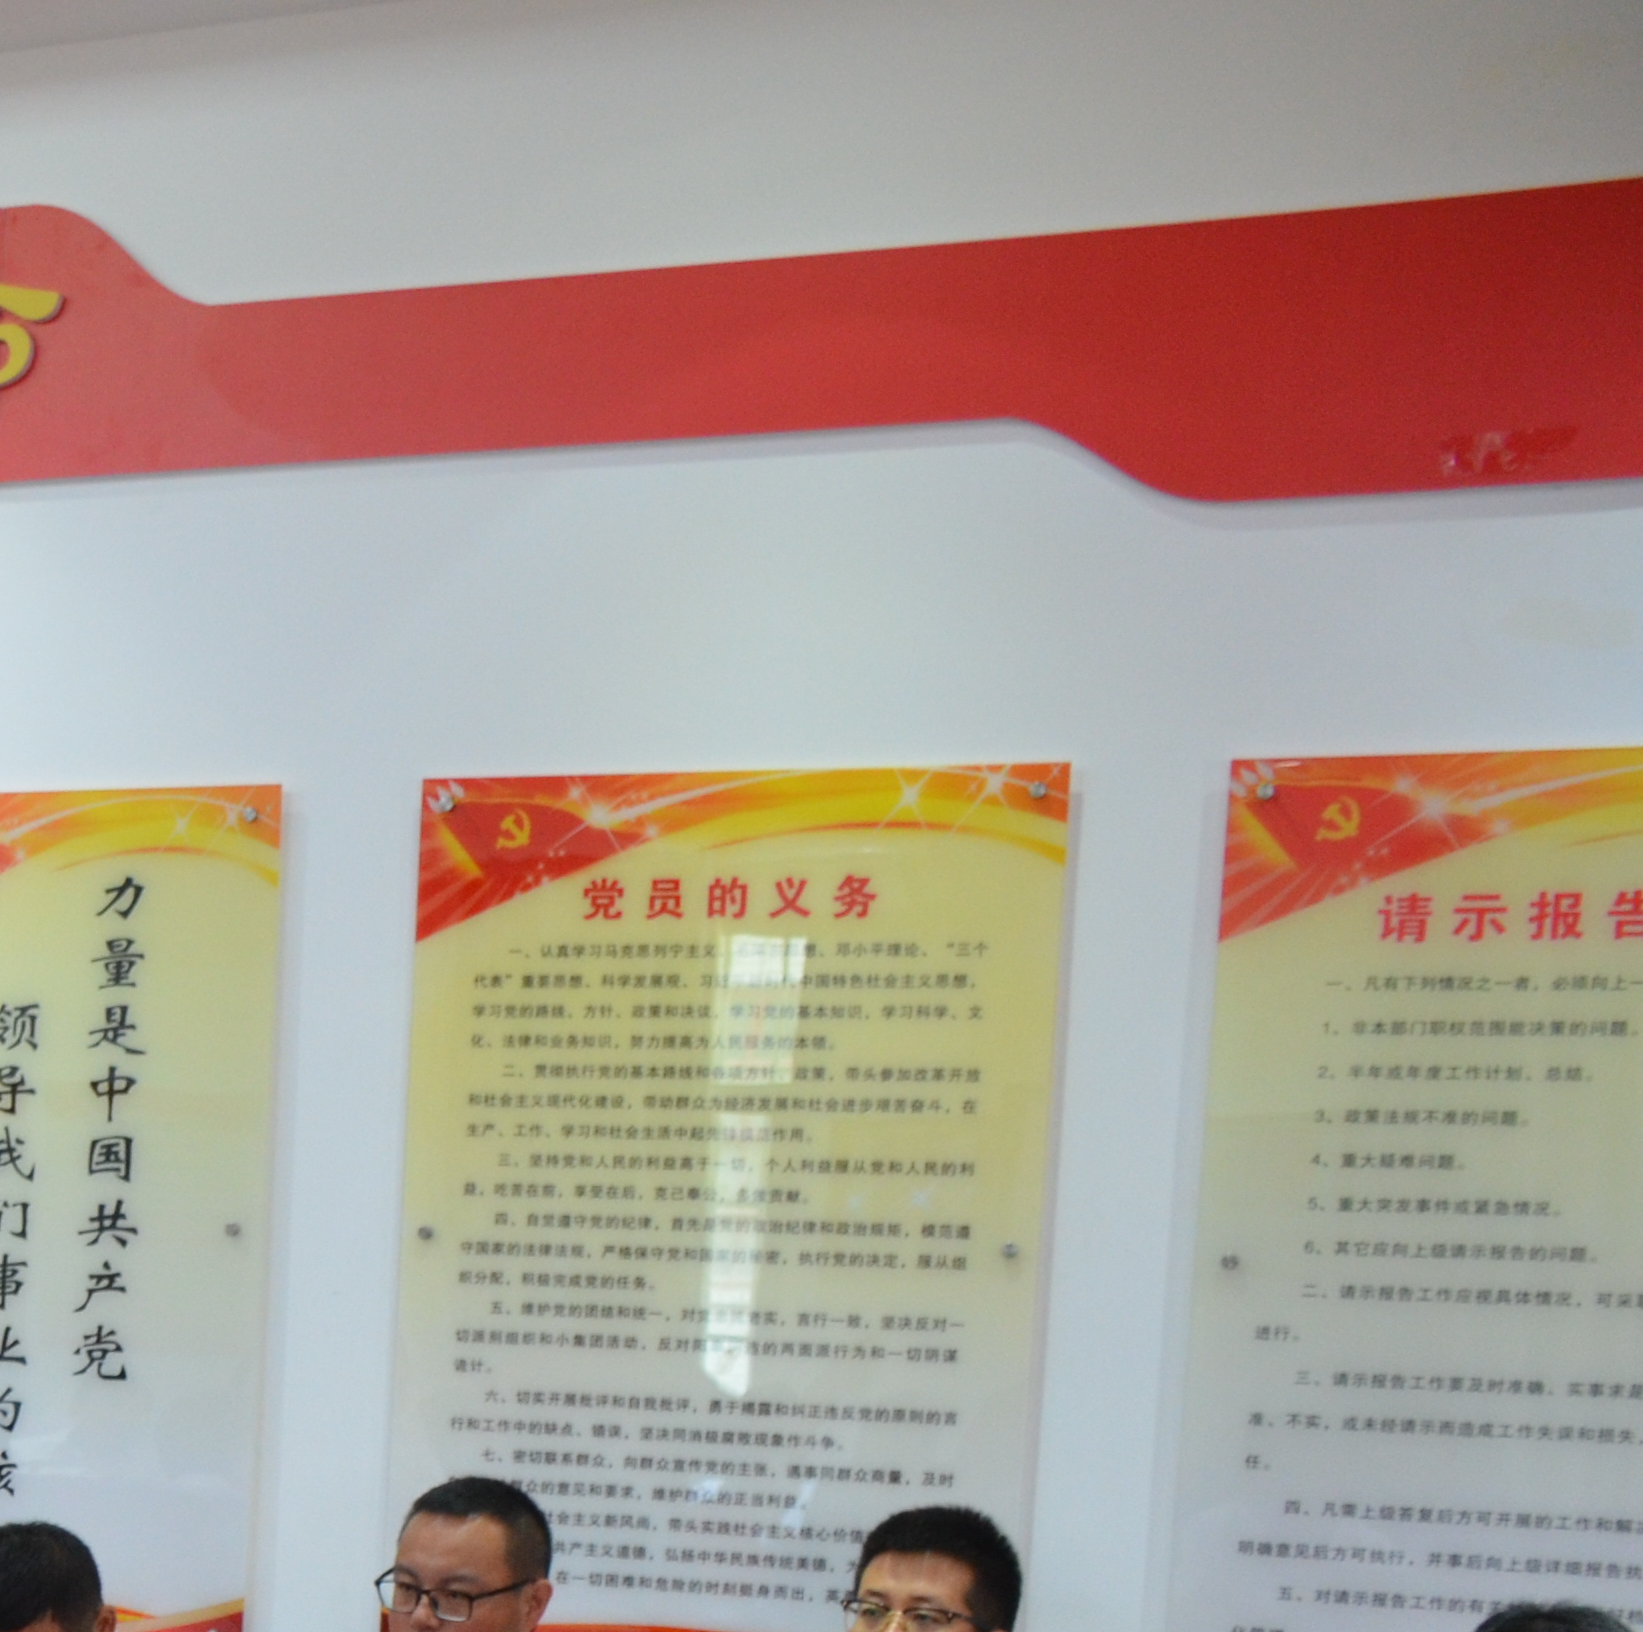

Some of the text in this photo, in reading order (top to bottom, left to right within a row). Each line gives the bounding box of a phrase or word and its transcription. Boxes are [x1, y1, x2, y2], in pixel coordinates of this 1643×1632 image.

[581, 874, 877, 921] 党员的义务
[1377, 890, 1643, 944] 请示报告
[72, 876, 147, 1383] 力量是中国共产党
